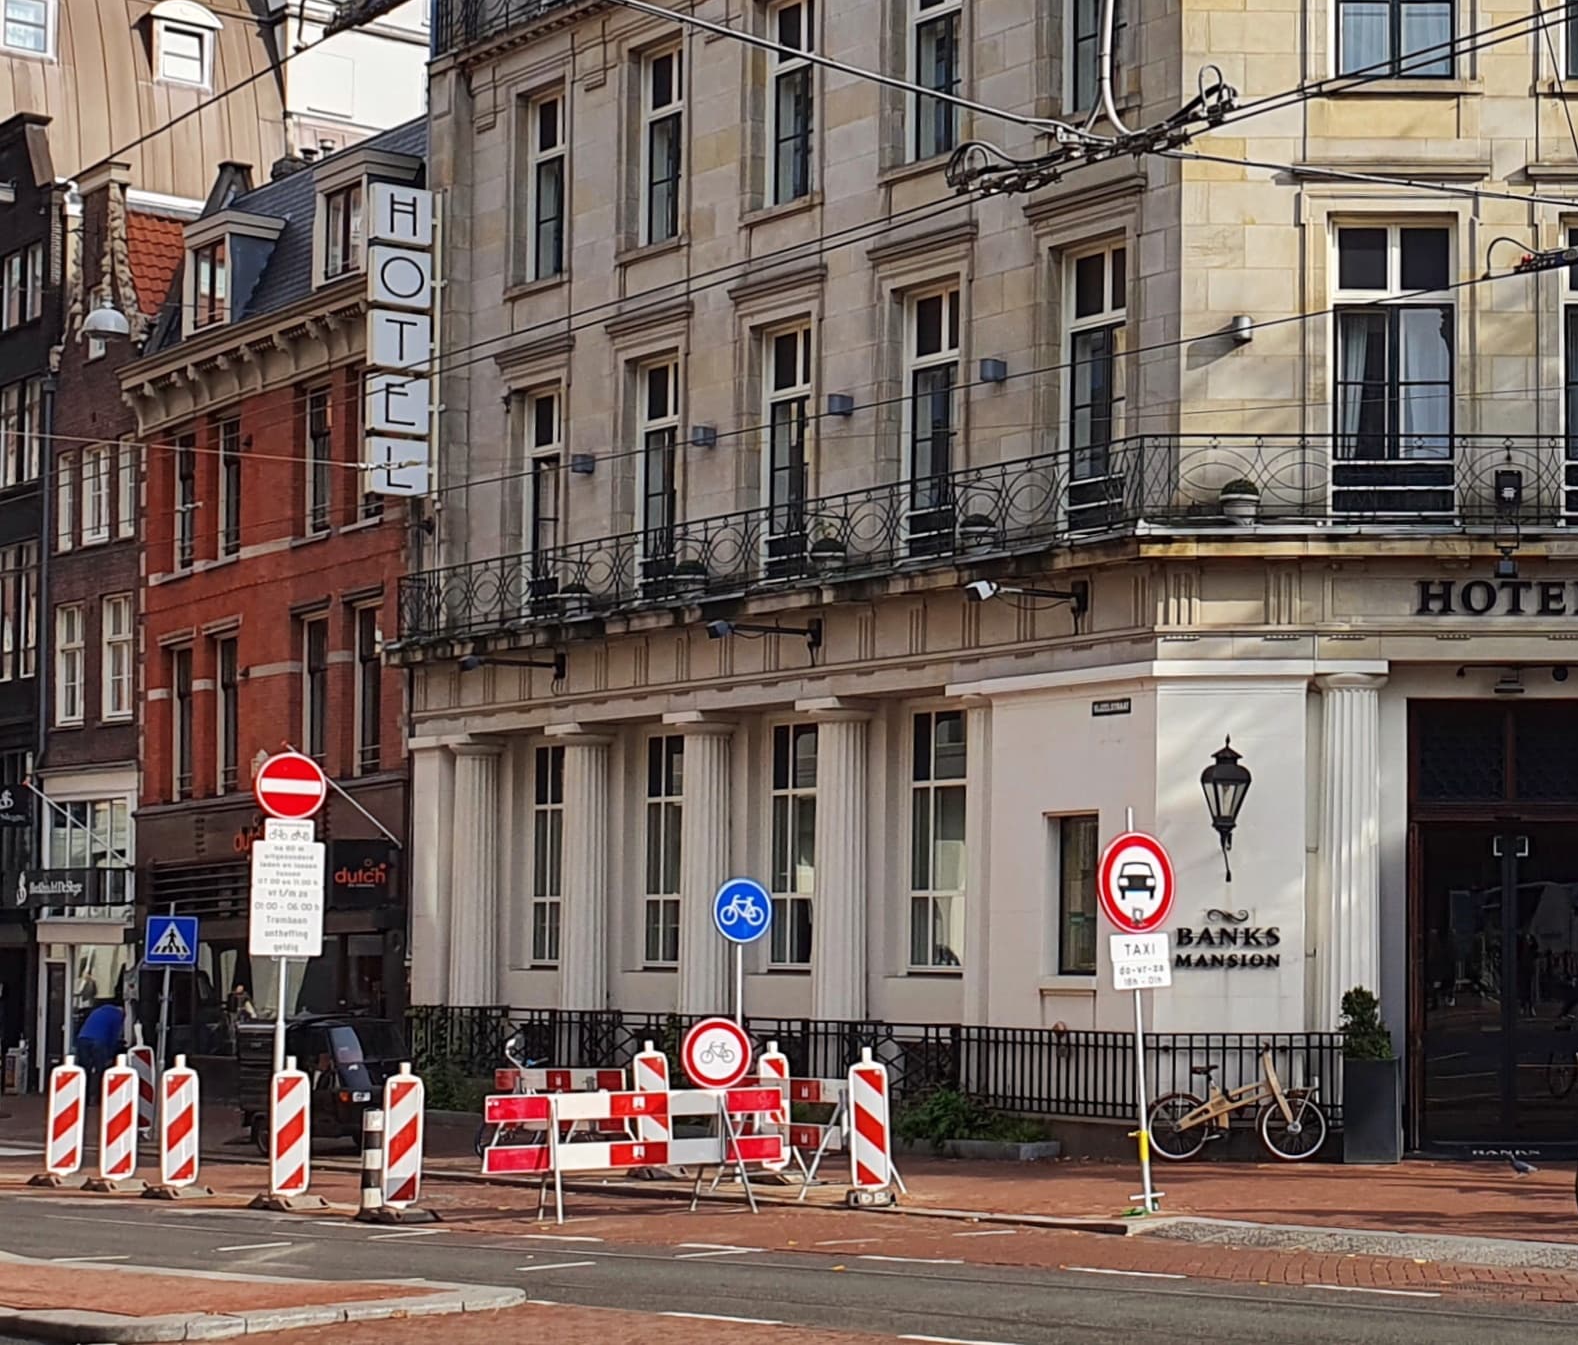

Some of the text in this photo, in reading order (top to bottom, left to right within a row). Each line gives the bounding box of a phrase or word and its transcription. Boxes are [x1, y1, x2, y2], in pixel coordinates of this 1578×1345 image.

[380, 192, 424, 490] HOTEL
[335, 863, 387, 884] dutch
[266, 915, 308, 924] Trambaan
[264, 930, 309, 940] ontheffing
[1176, 927, 1281, 947] BANKS
[273, 943, 299, 952] geldig
[1123, 943, 1157, 957] TAXI
[1174, 954, 1281, 969] MANSION
